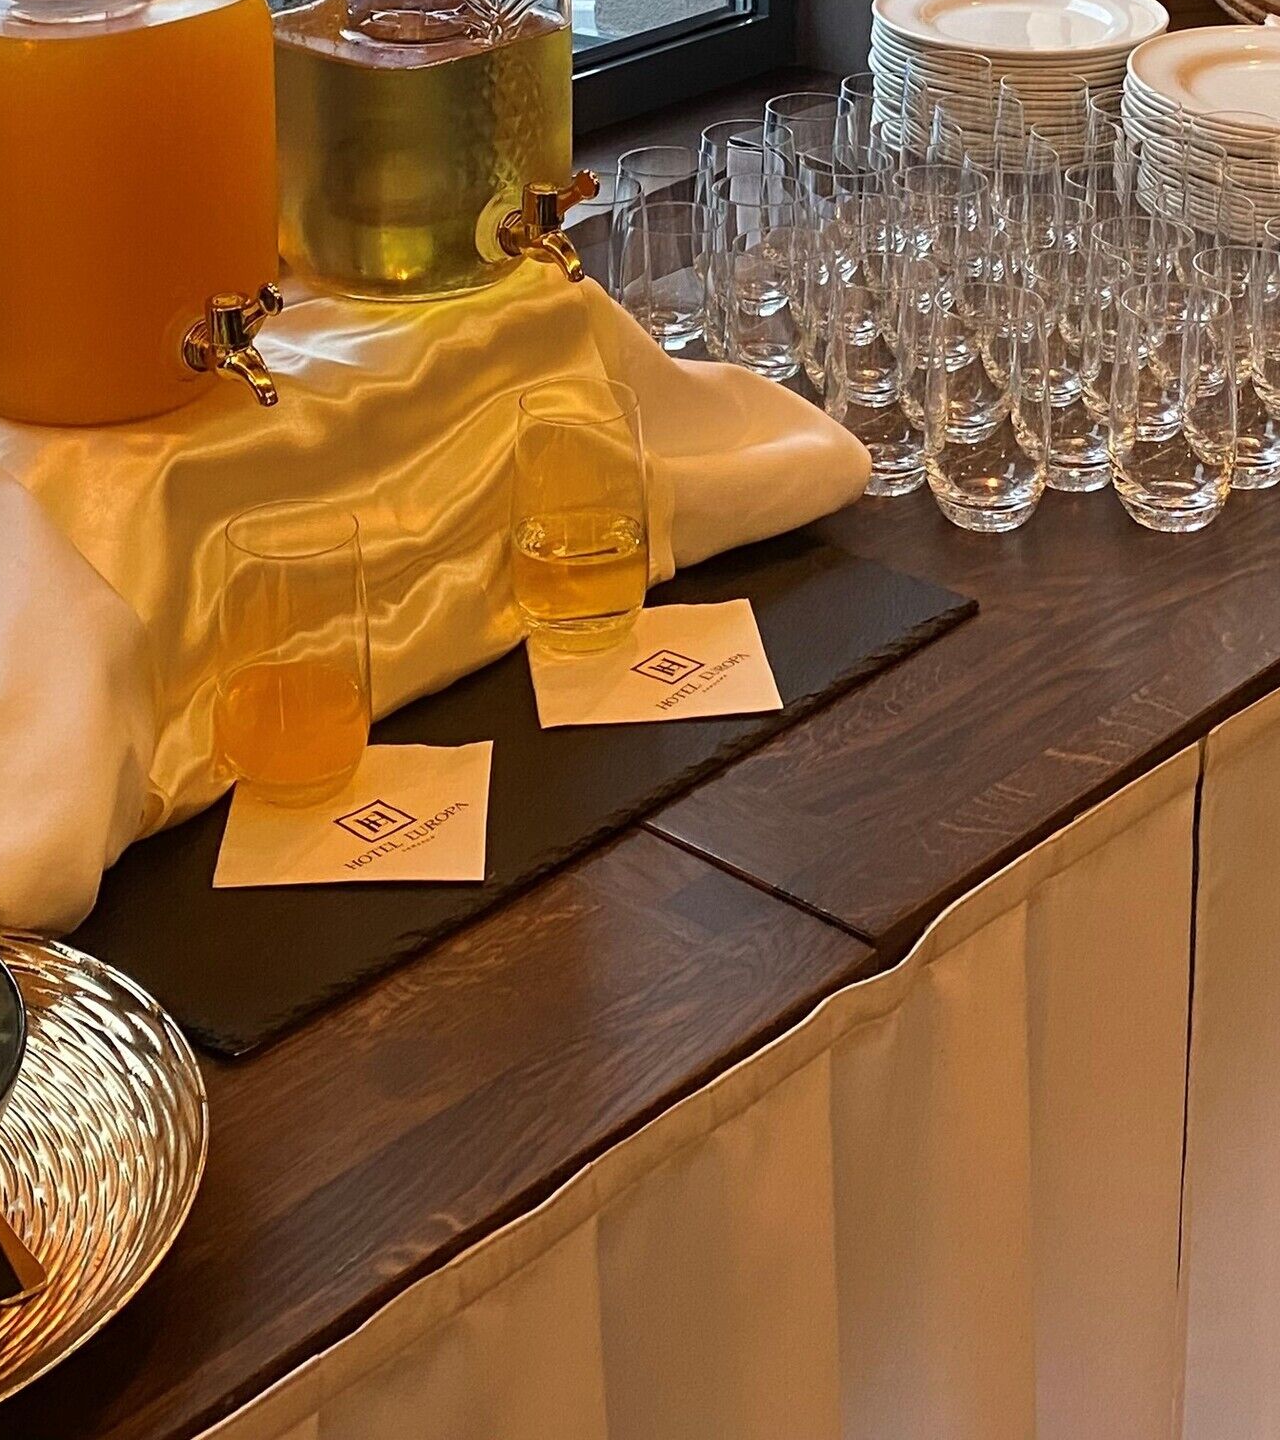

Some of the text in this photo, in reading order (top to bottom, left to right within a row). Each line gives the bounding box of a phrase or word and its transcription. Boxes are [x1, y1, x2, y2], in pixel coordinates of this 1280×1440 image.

[655, 682, 703, 710] HOTEL
[699, 652, 751, 681] EUROPA
[344, 841, 404, 870] HOTEL
[403, 801, 470, 841] EUROPA
